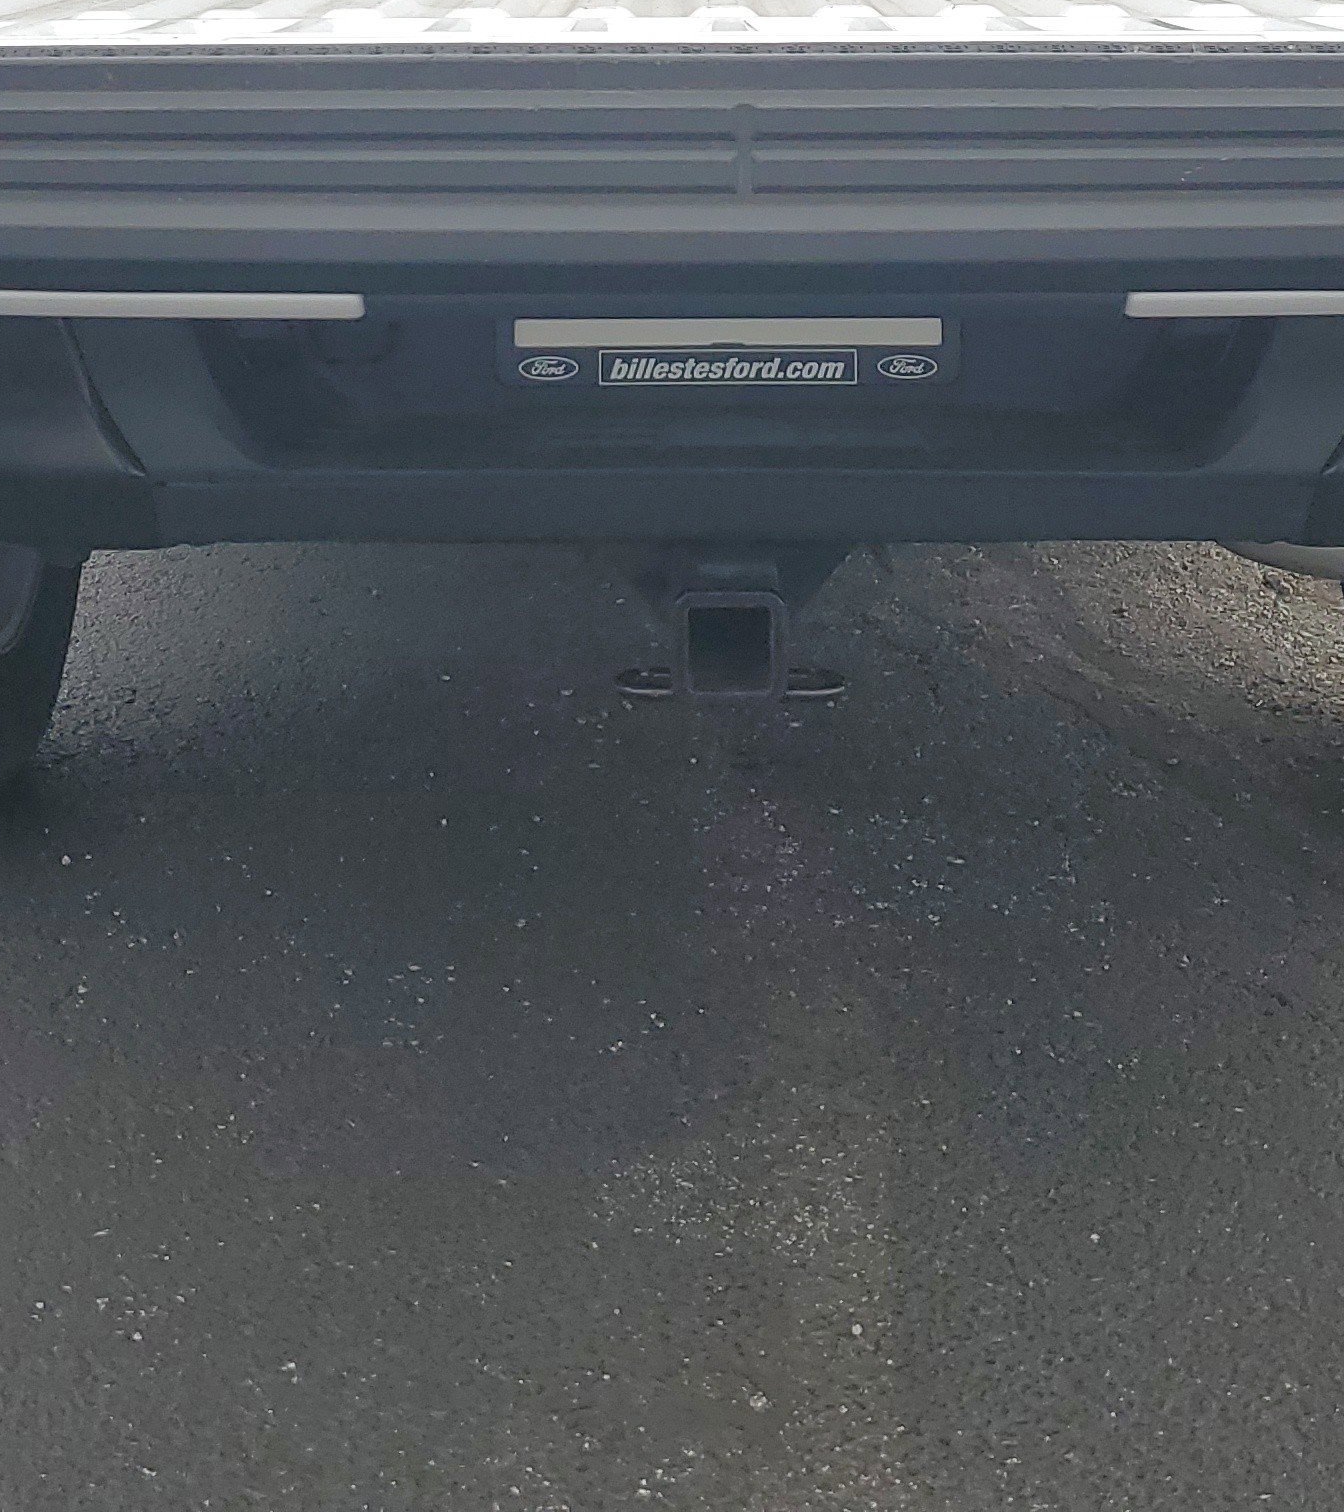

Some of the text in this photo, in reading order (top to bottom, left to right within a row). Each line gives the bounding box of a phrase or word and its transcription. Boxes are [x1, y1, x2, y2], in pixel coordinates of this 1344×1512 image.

[529, 358, 567, 378] Ford
[609, 357, 845, 381] billestesford.com
[887, 358, 926, 377] Ford
